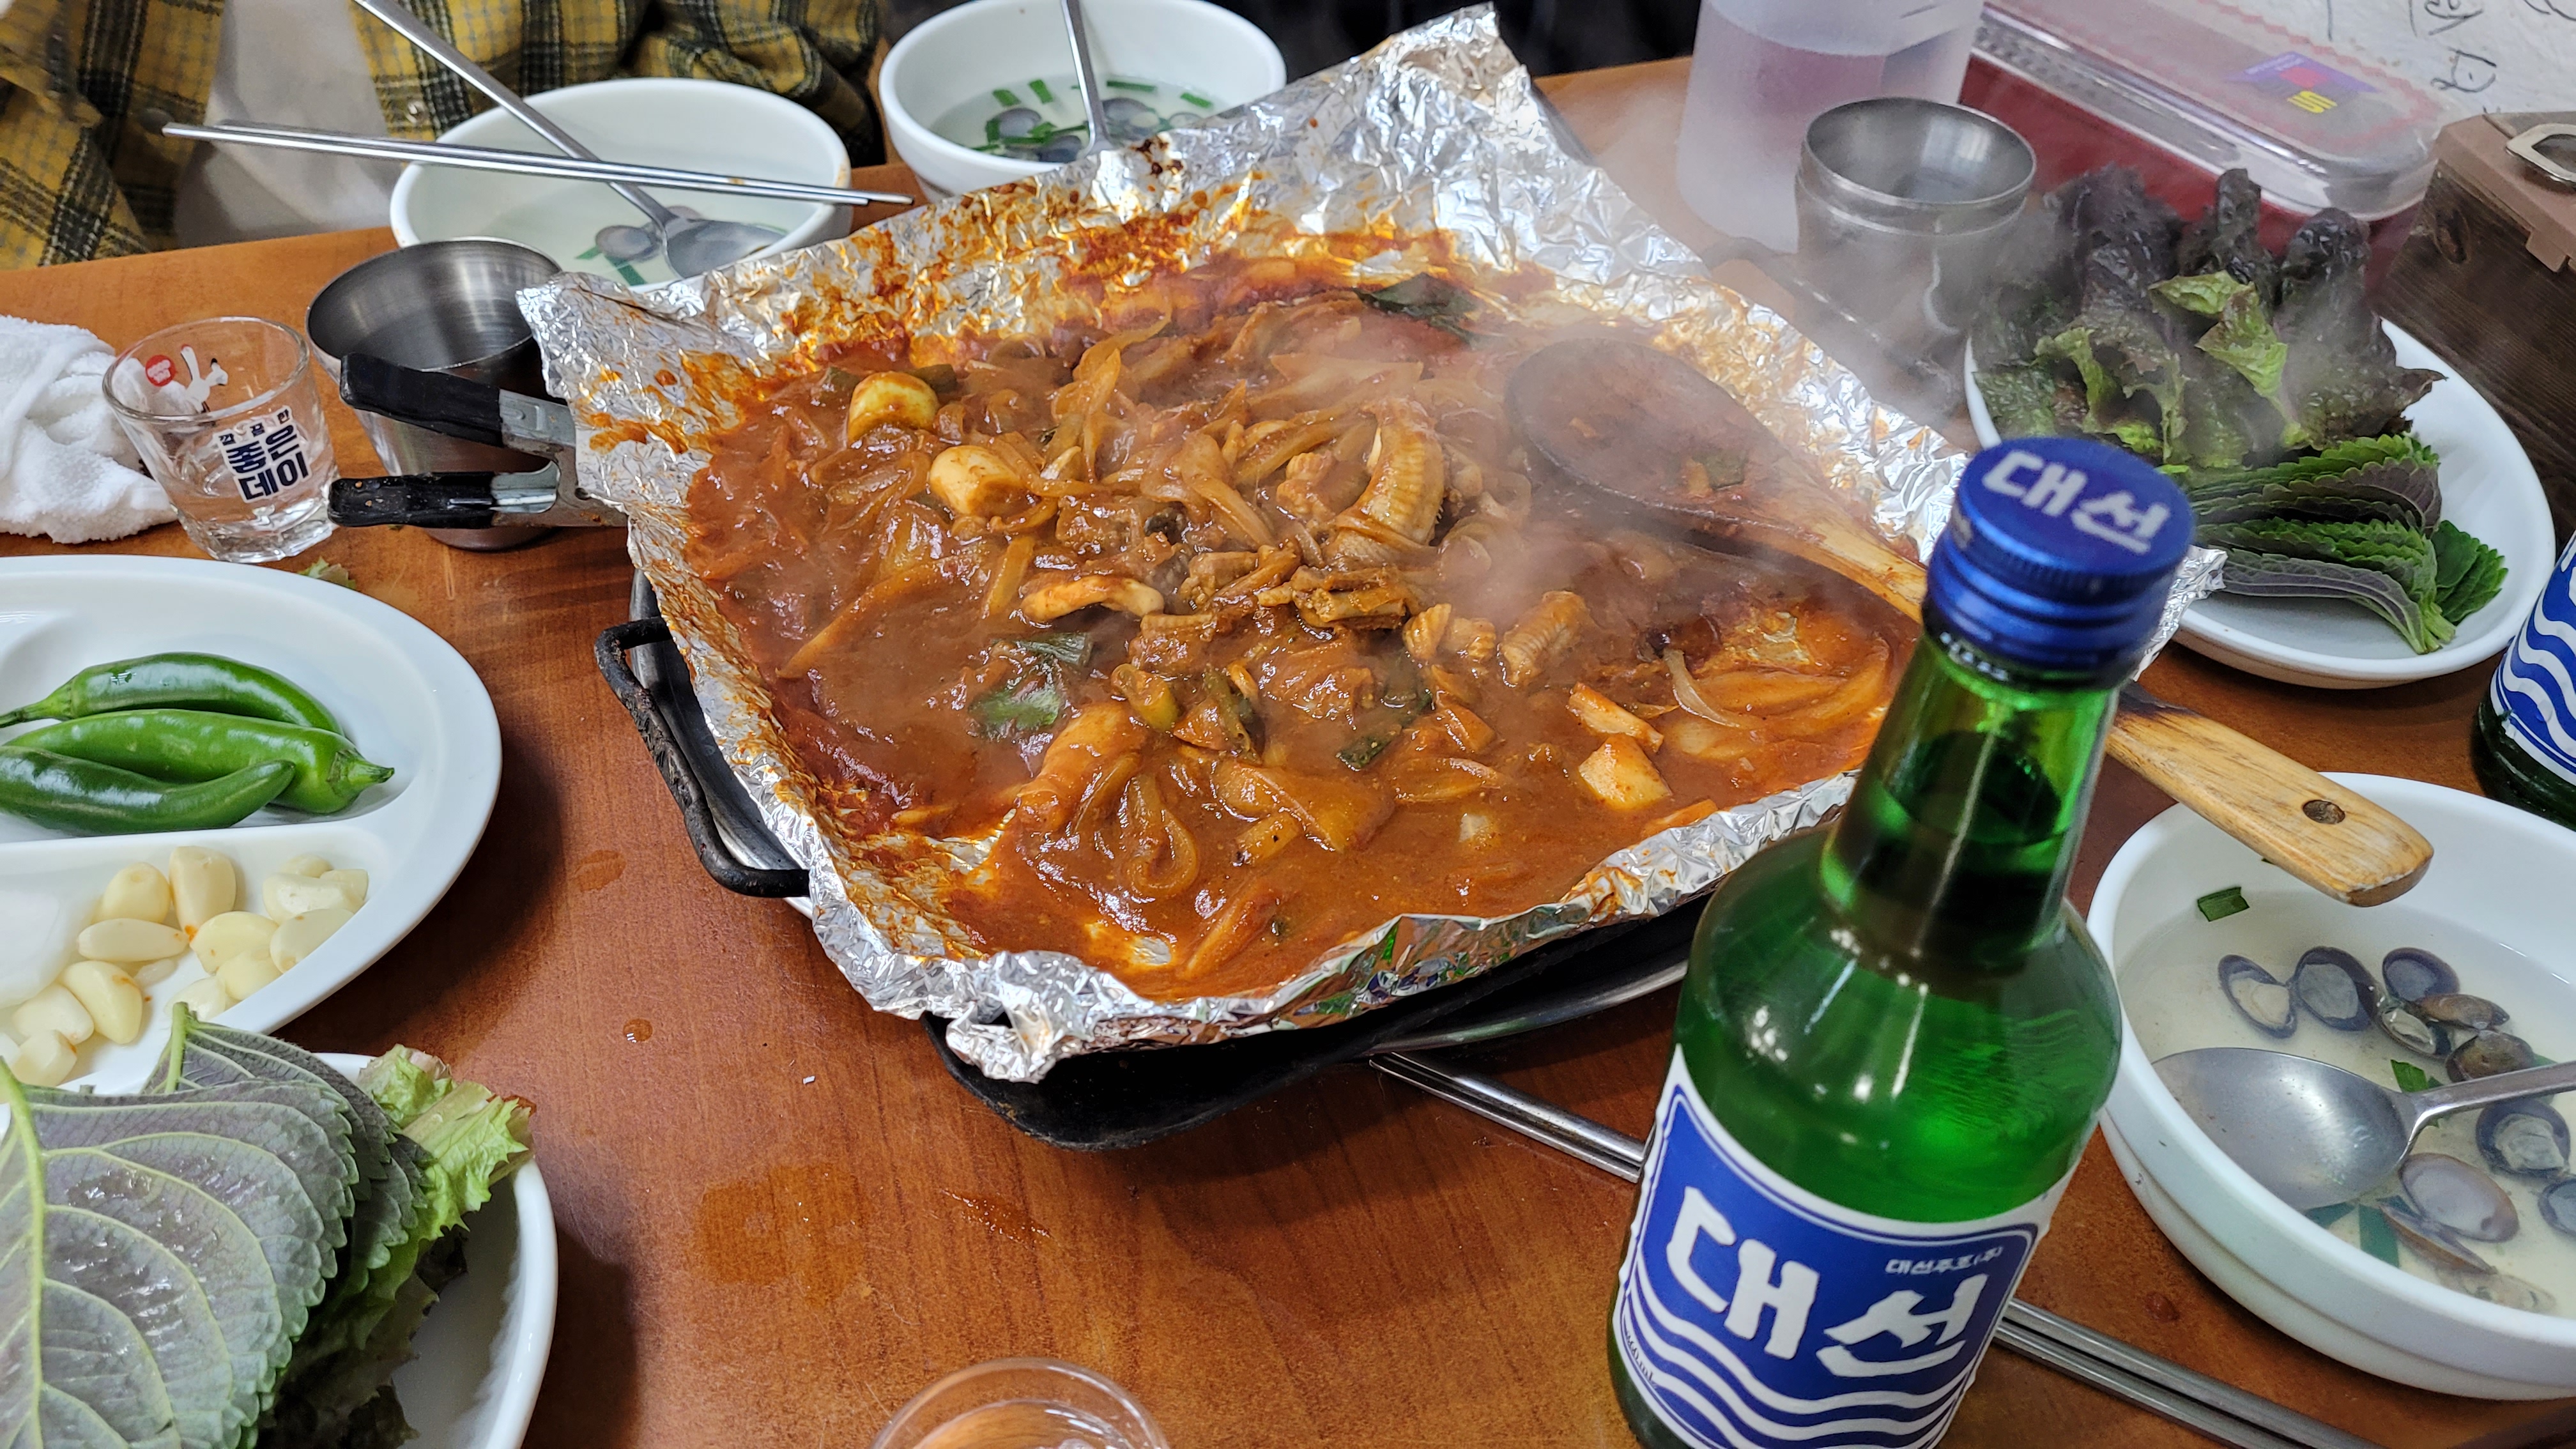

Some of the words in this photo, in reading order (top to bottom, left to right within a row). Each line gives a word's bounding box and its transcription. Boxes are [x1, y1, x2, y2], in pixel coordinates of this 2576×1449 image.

[226, 424, 300, 474] 좋은
[238, 450, 309, 501] 데이
[1982, 450, 2170, 555] 대선
[1666, 1186, 1988, 1377] 대선
